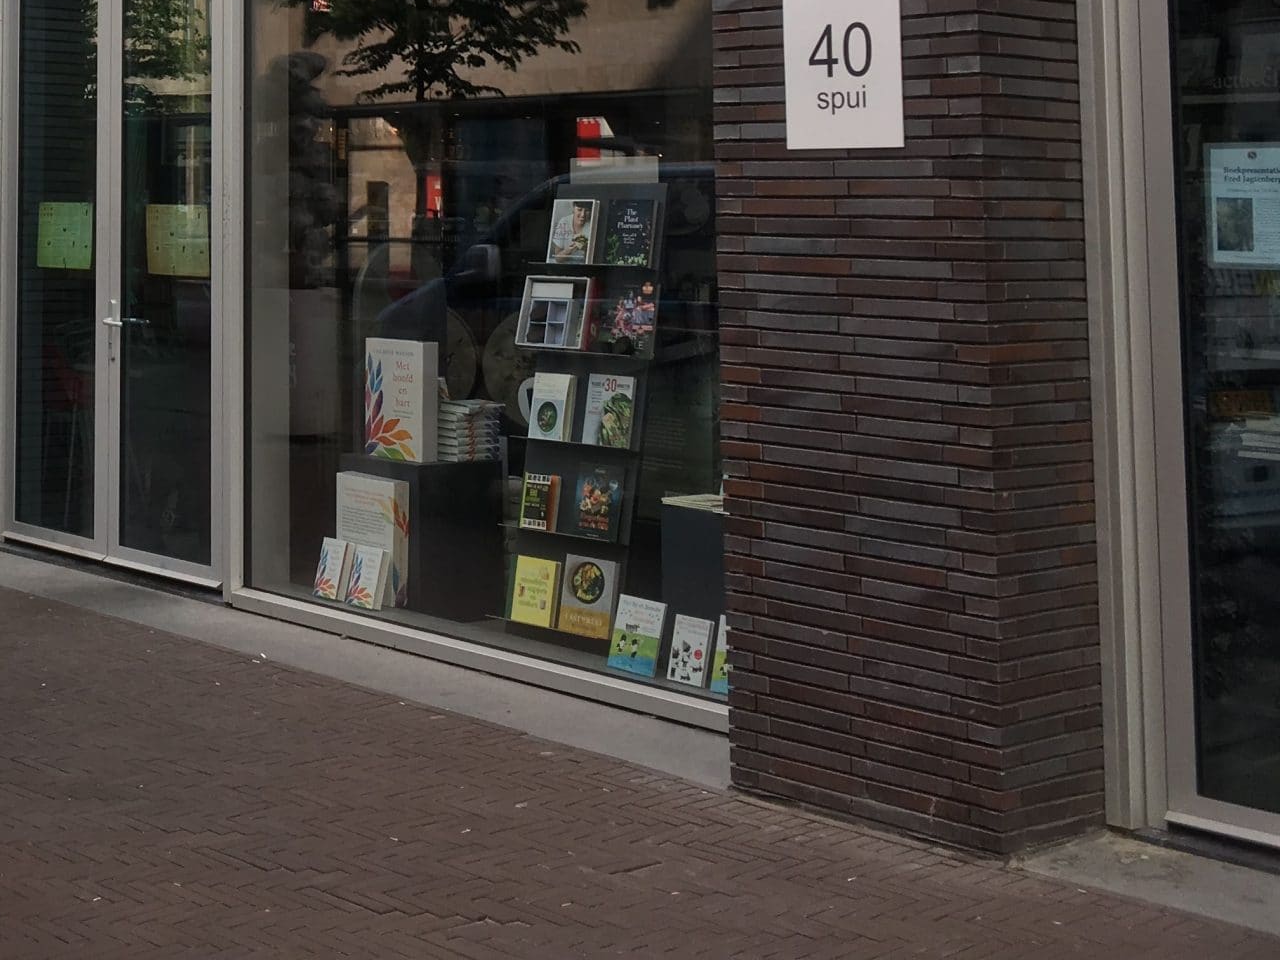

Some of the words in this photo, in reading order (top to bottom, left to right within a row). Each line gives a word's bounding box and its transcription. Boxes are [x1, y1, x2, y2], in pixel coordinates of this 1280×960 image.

[808, 21, 872, 78] 40
[817, 84, 867, 115] spui
[603, 378, 617, 392] 30
